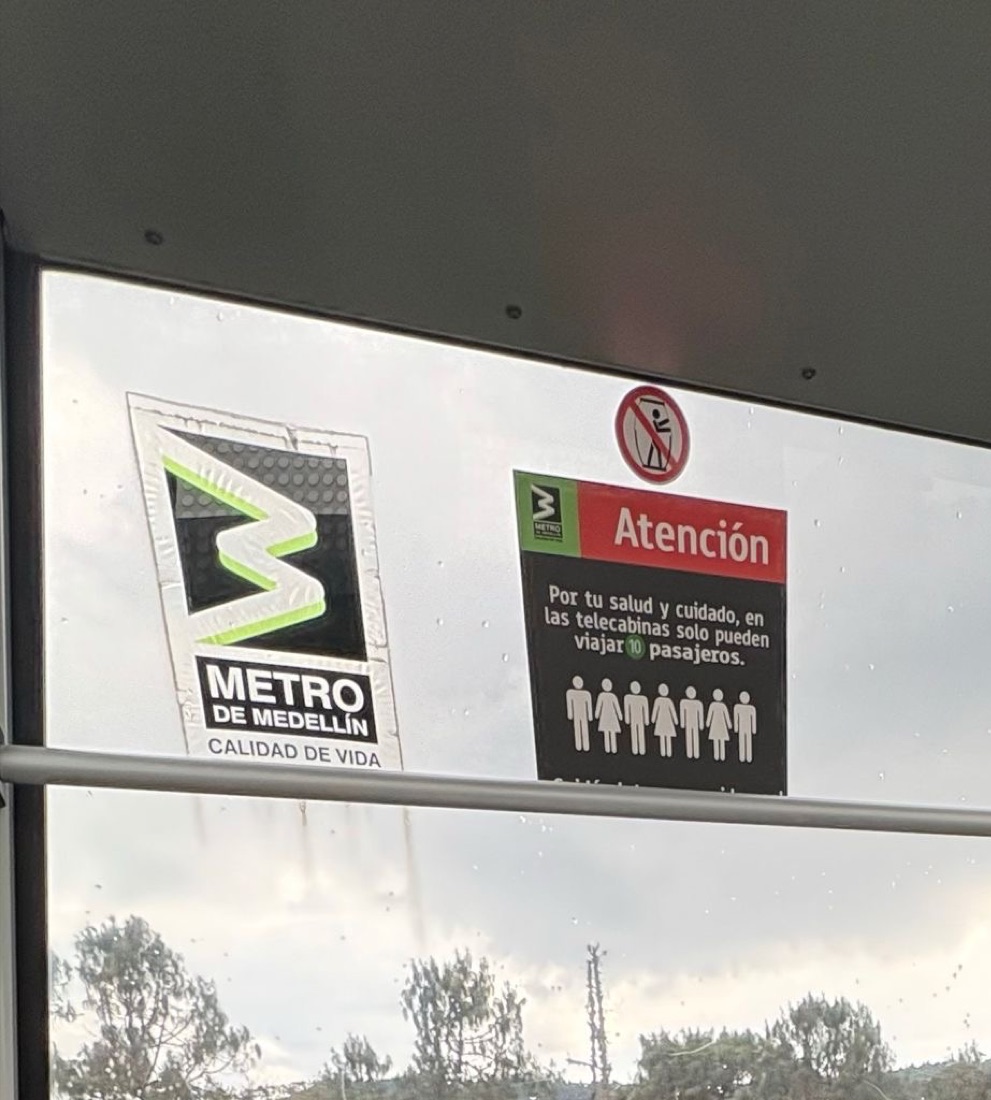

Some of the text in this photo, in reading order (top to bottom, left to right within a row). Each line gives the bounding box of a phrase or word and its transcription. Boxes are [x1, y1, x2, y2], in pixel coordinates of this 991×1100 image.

[615, 506, 769, 565] Atención
[549, 584, 764, 627] Por tu salud y cuidado, en
[544, 606, 770, 648] las telecabinas solo pueden
[574, 632, 746, 666] viajar 10 pasajeros.
[205, 664, 364, 713] METRO
[213, 704, 369, 737] DE MEDELLÍN
[208, 738, 382, 768] CALIDAD DE VIDA
